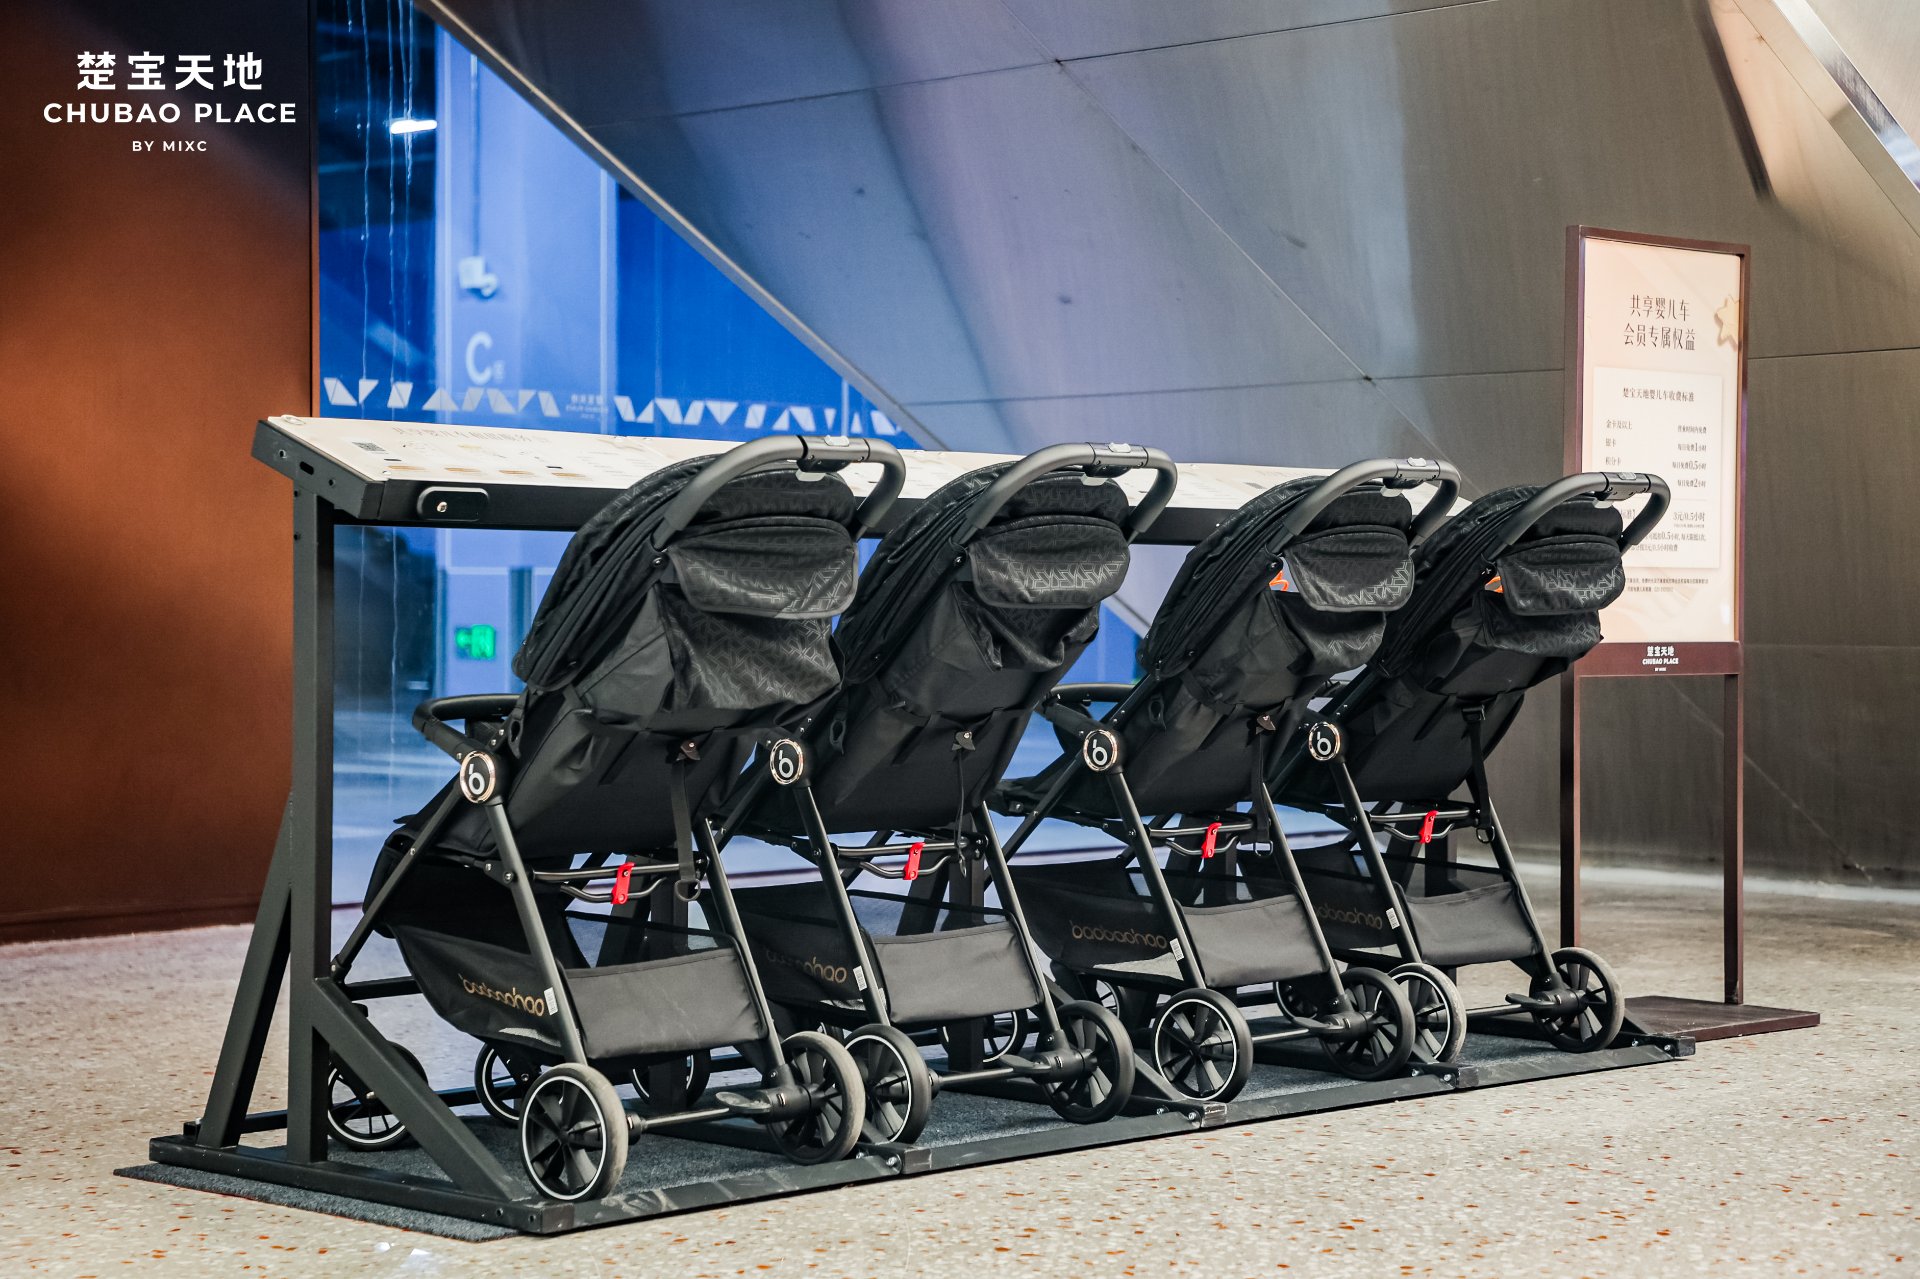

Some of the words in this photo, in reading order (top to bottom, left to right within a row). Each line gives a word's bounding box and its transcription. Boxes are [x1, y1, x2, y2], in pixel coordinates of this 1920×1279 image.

[1629, 294, 1690, 321] 共享婴儿车
[1623, 322, 1696, 351] 会员专属权益
[465, 331, 493, 386] C
[1623, 387, 1695, 402] 楚宝天地婴儿车收费标准
[1647, 645, 1675, 657] 楚宝天地
[1663, 657, 1679, 665] PLACE
